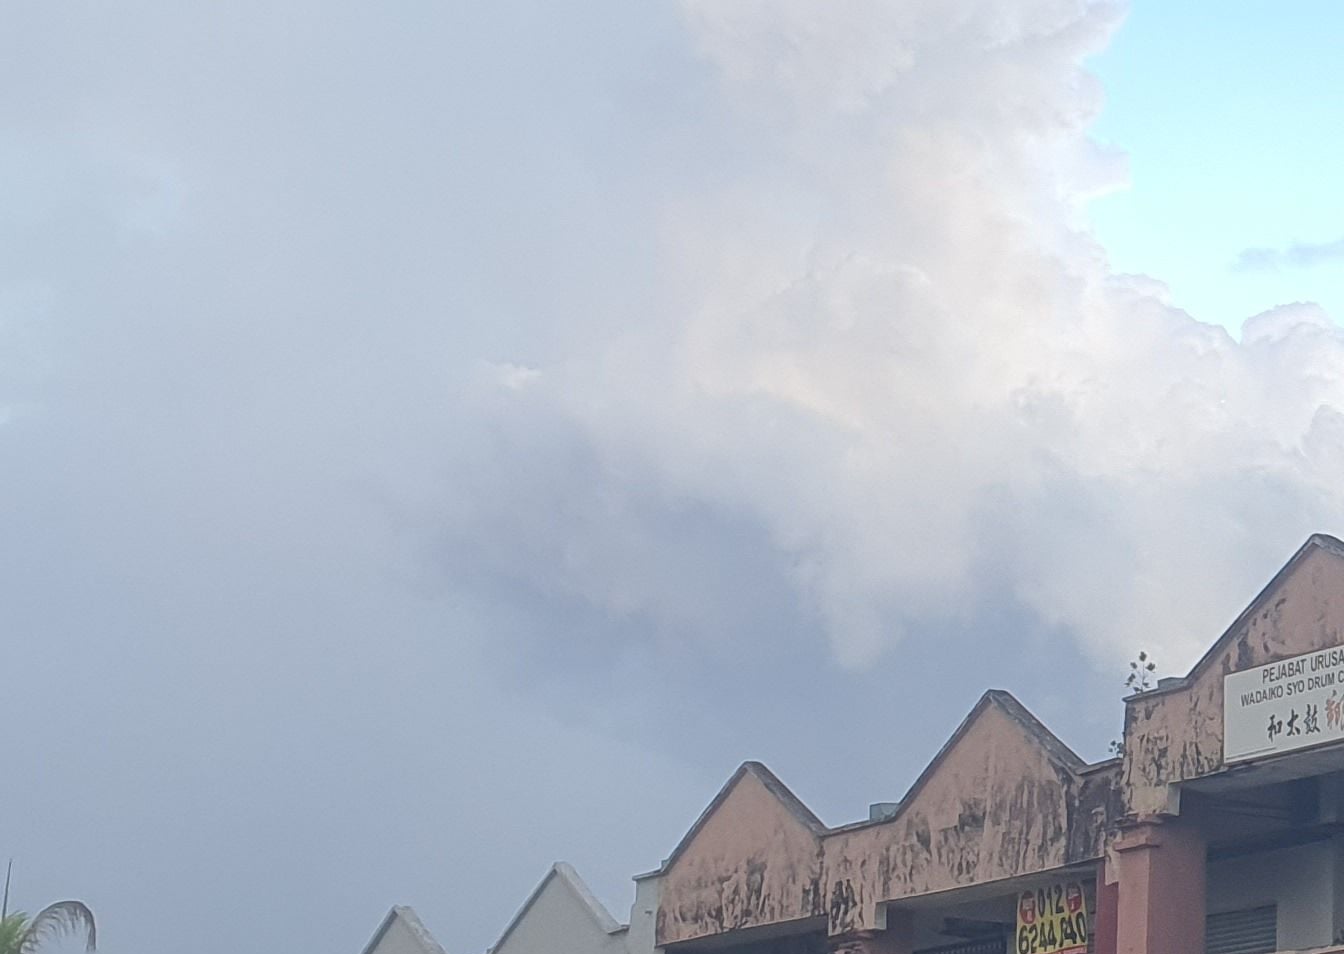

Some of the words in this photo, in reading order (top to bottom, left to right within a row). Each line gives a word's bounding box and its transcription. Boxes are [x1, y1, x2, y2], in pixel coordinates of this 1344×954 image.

[1262, 658, 1307, 684] PEJABAT
[1241, 685, 1284, 707] WADAIKO
[1286, 680, 1305, 696] SYO
[1307, 673, 1335, 691] DRUM
